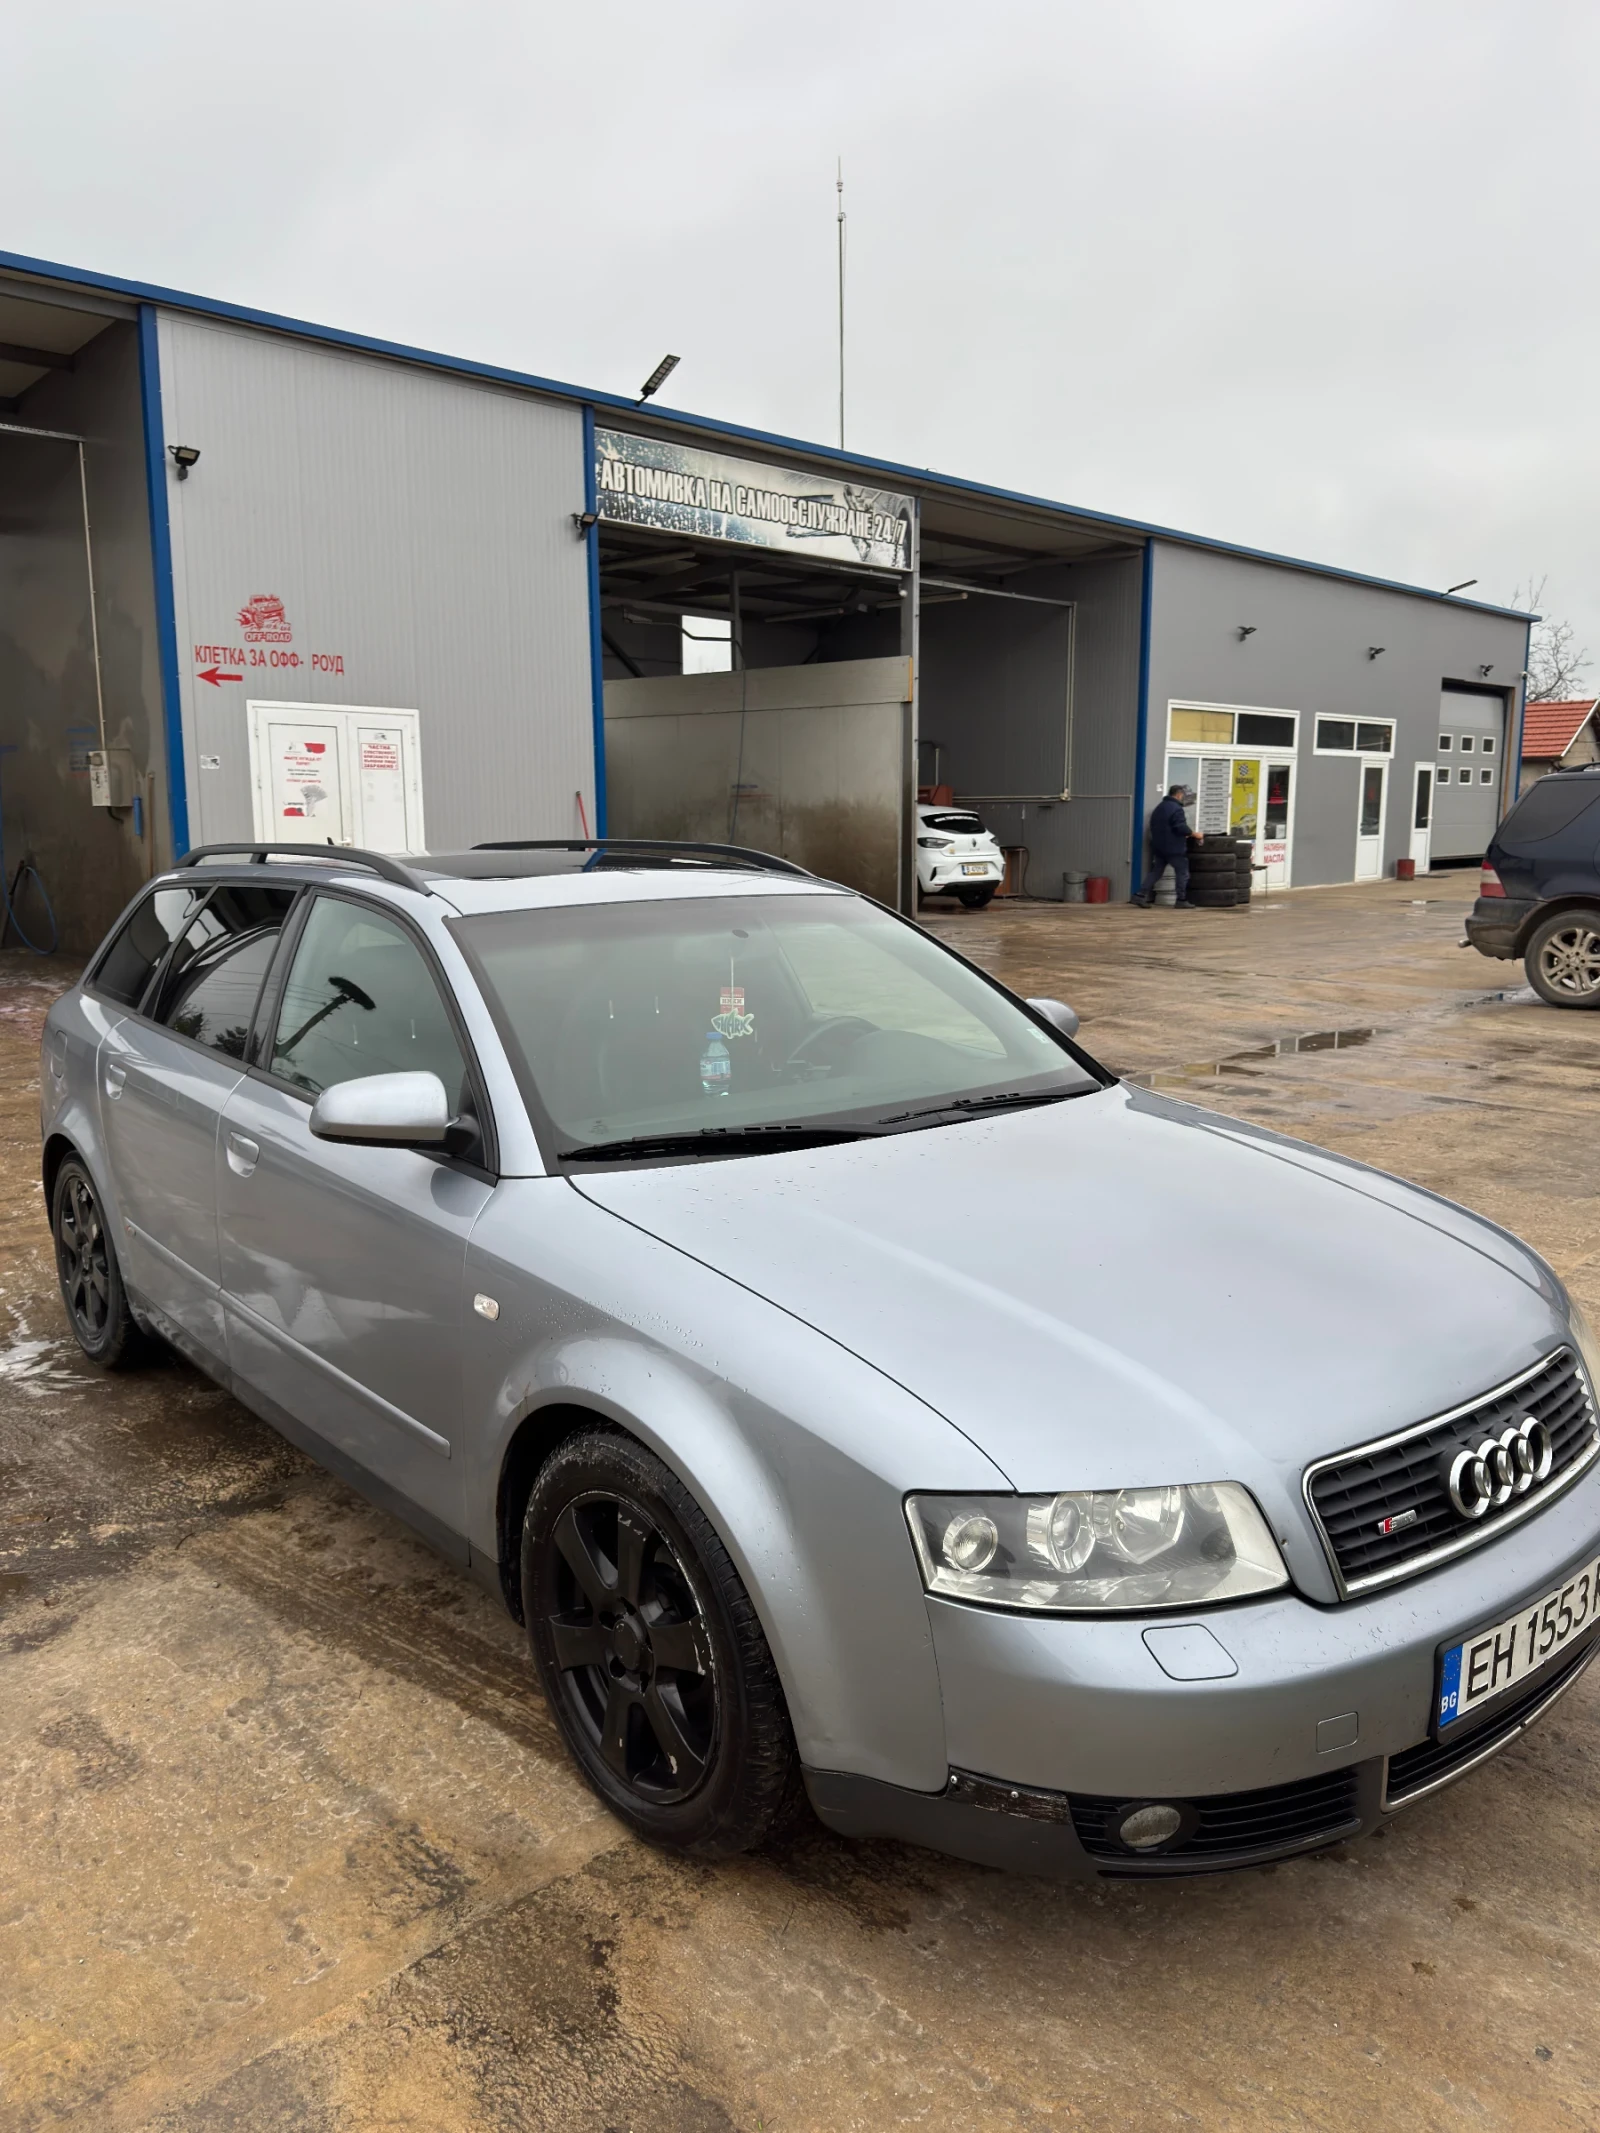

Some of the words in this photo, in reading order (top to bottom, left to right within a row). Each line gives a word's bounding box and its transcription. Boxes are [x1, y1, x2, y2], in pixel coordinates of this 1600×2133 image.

[600, 458, 706, 508] АВТОМИВКА
[710, 479, 733, 515] НА
[735, 486, 874, 541] САМООБСЛУЖВАНЕ
[873, 513, 908, 547] 24/7
[244, 632, 292, 642] OFF-ROAD
[194, 645, 247, 666] КЛЕТКА
[249, 649, 267, 667] ЗА
[269, 649, 304, 668] ОФФ-
[312, 654, 344, 676] РОУД
[1263, 853, 1286, 864] МАСЛА
[713, 1012, 753, 1036] SHARK
[1466, 1625, 1517, 1702] EH
[1528, 1574, 1591, 1665] 1553
[1440, 1692, 1457, 1714] BG
